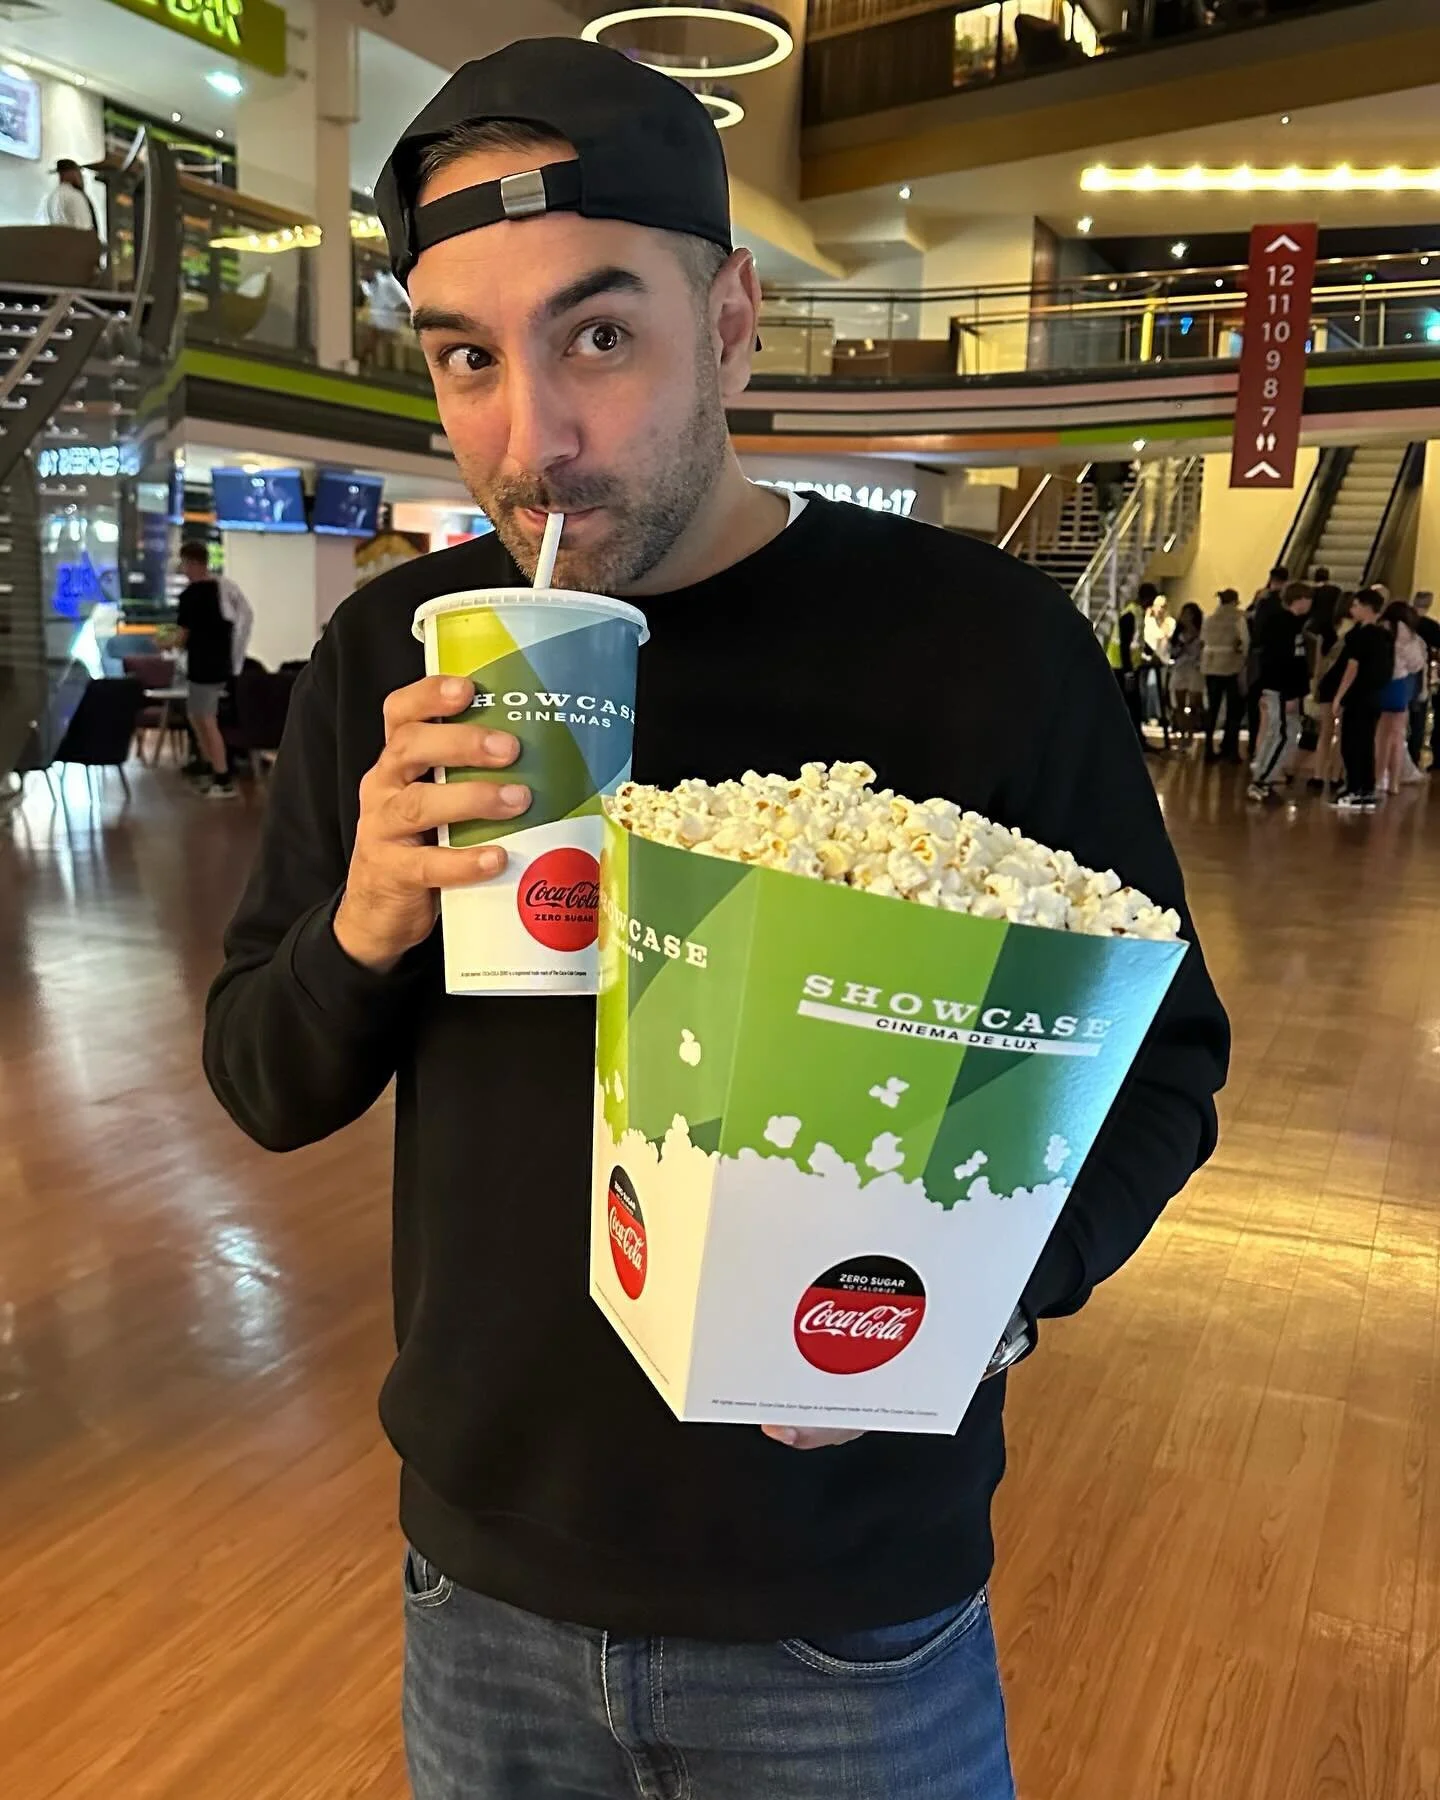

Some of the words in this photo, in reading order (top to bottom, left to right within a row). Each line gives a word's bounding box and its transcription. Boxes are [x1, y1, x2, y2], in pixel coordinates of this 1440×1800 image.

[1266, 264, 1295, 286] 12
[1267, 294, 1290, 315] 11
[1180, 317, 1193, 335] 7
[1261, 321, 1291, 343] 10
[1265, 350, 1281, 371] 9
[1263, 378, 1279, 399] 8
[1261, 407, 1276, 427] 7
[470, 691, 636, 725] HOWCAS
[507, 710, 612, 728] CINEMAS
[525, 879, 600, 910] Coca-Cola
[534, 913, 561, 921] ZERO
[562, 914, 594, 923] SUGAR
[802, 974, 1112, 1039] SHOWCASE
[876, 1018, 959, 1041] CINEMA
[968, 1034, 993, 1046] DE
[1003, 1037, 1039, 1051] LUX
[609, 1206, 645, 1270] Coca-Cola
[839, 1273, 869, 1285] ZERO
[870, 1276, 906, 1288] SUGAR
[799, 1300, 920, 1340] Coca-Cola
